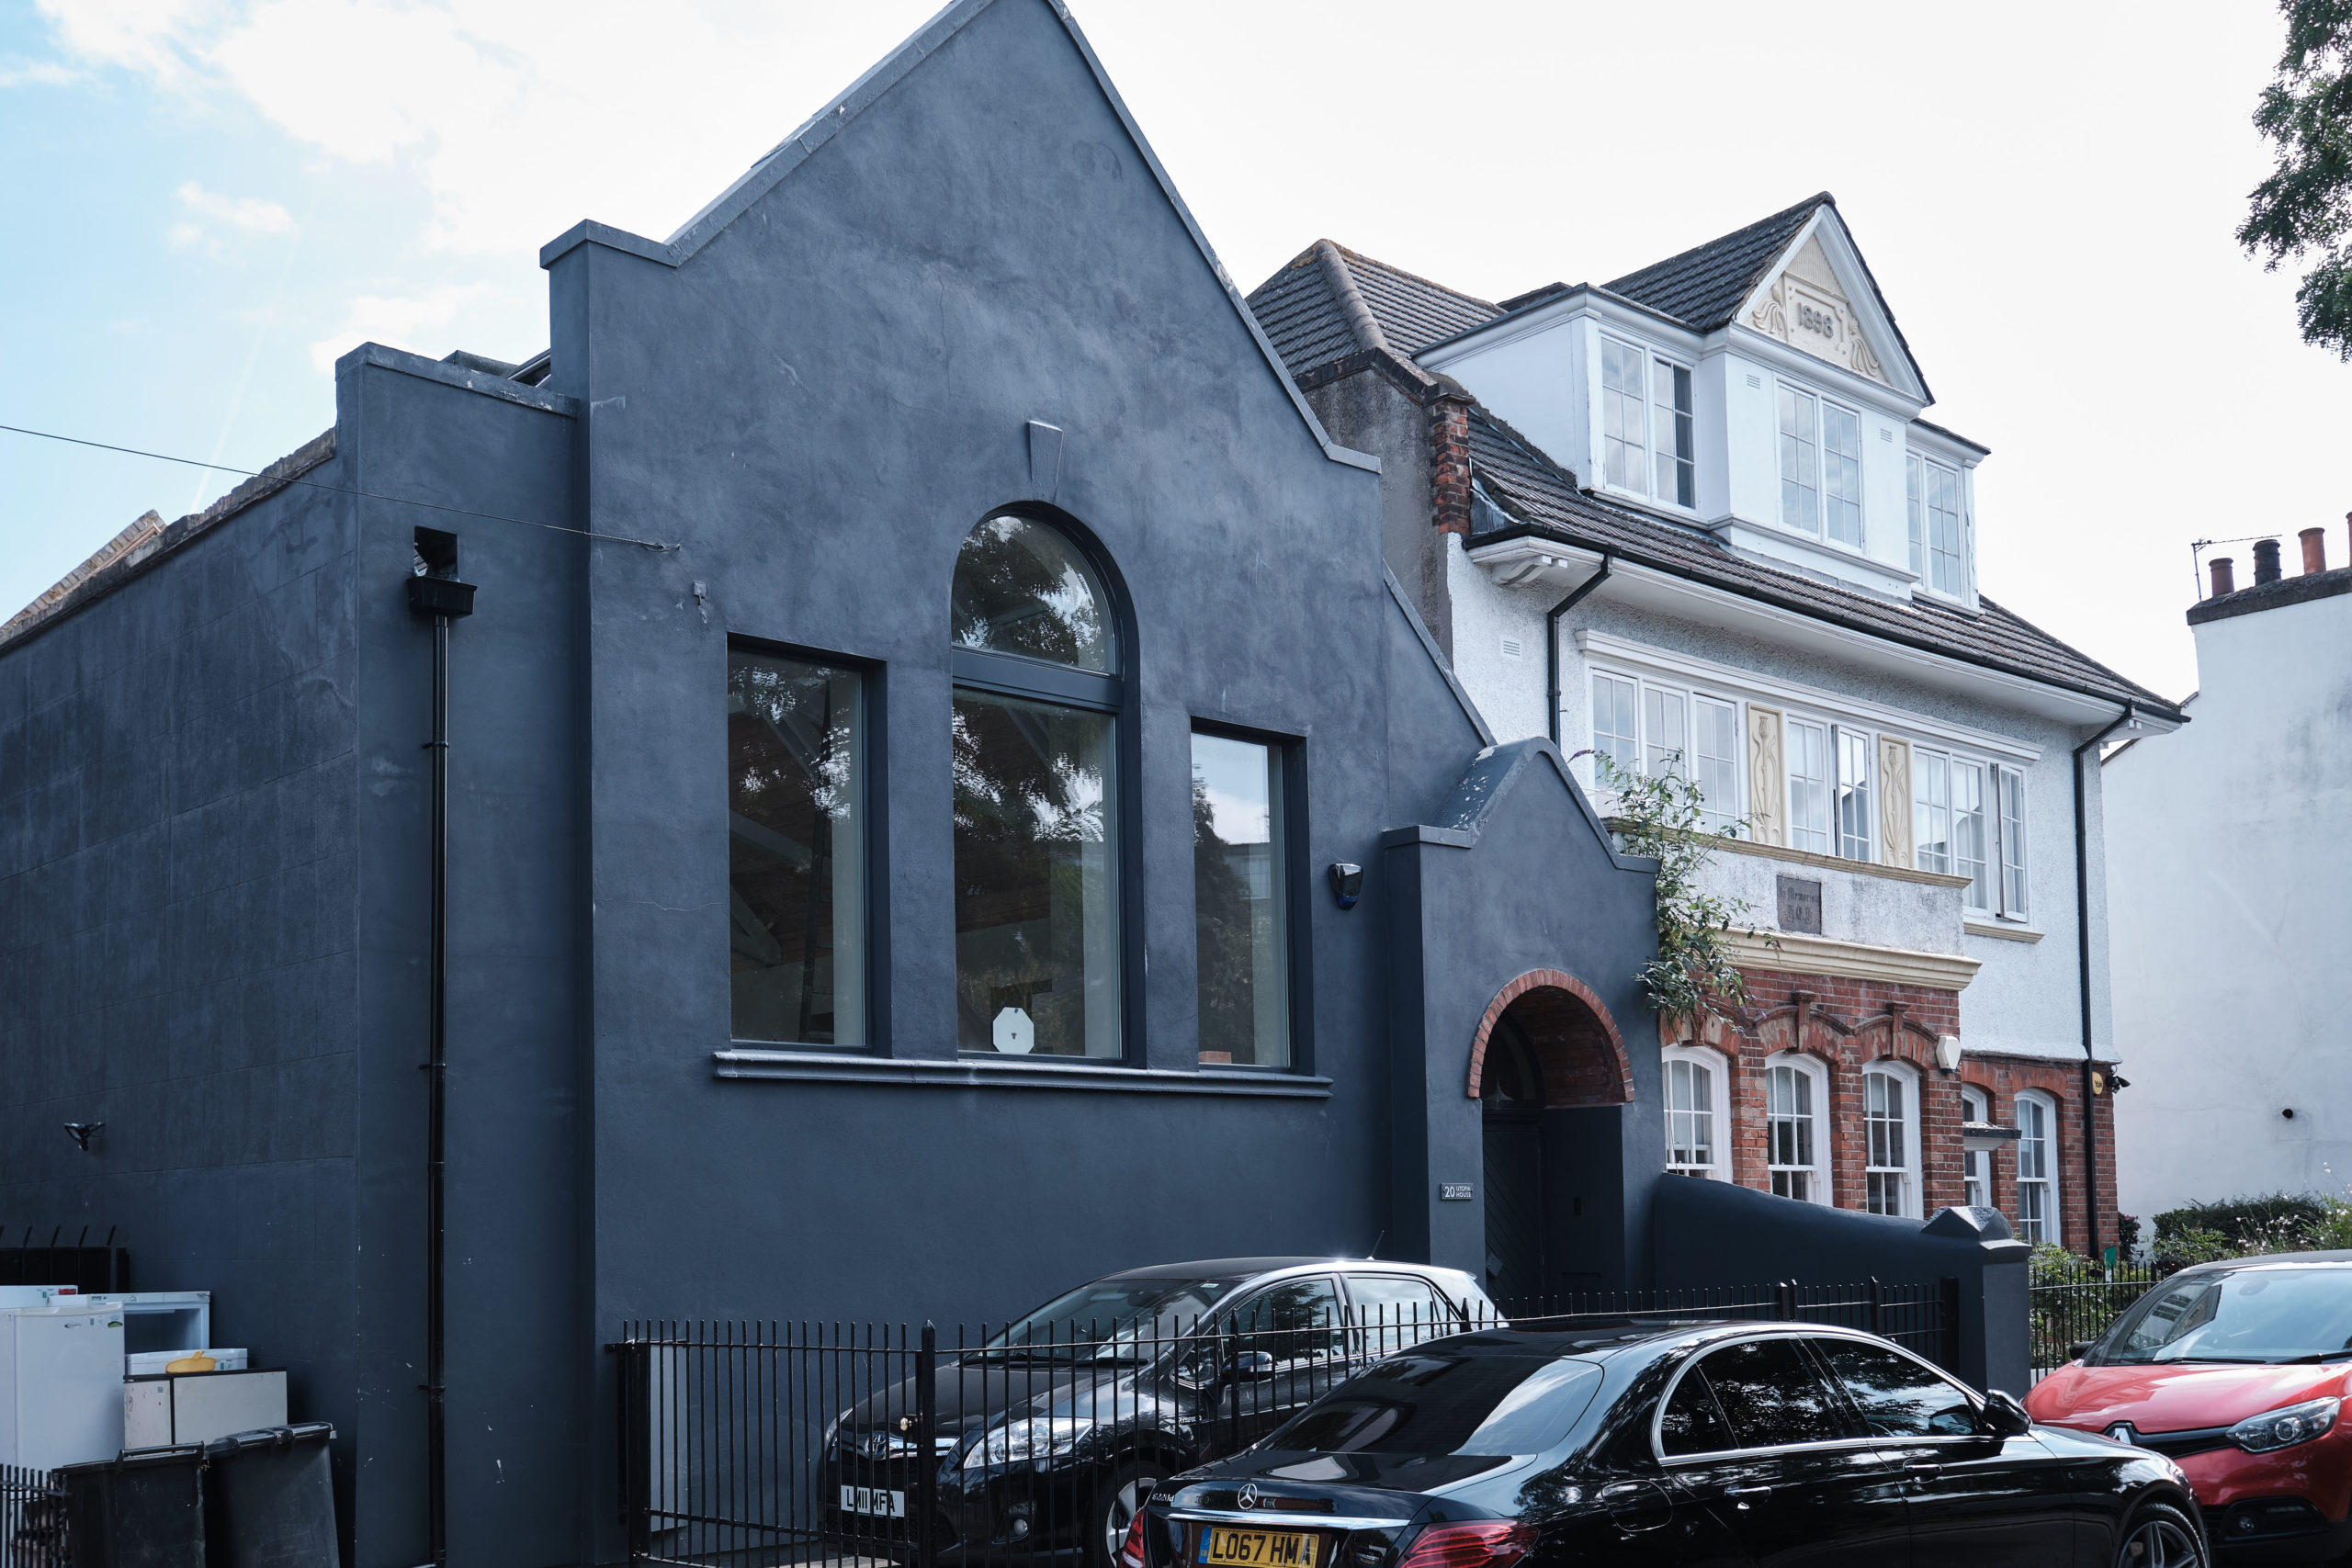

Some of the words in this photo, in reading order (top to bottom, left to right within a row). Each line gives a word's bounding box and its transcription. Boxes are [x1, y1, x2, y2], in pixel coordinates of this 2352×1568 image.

[1797, 302, 1834, 338] 1898
[1444, 1186, 1455, 1198] 20
[1212, 1532, 1266, 1562] LO67
[1270, 1535, 1311, 1566] HMA
